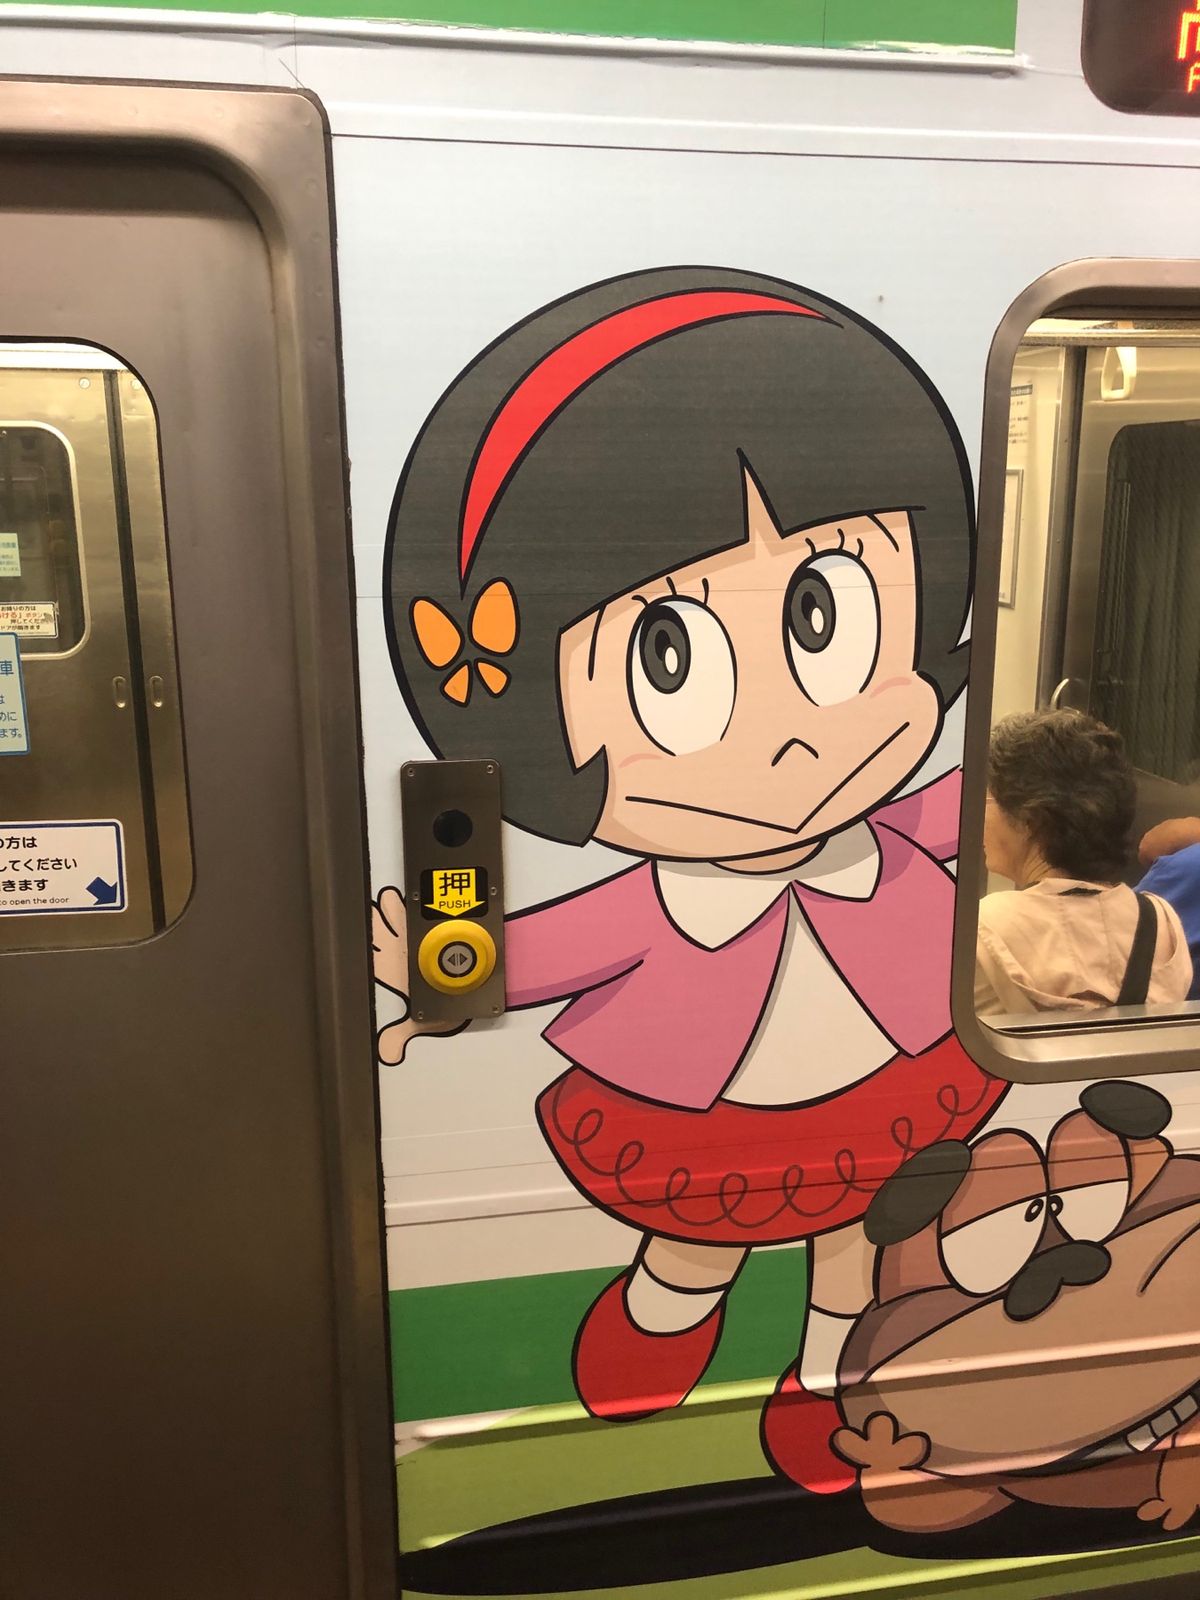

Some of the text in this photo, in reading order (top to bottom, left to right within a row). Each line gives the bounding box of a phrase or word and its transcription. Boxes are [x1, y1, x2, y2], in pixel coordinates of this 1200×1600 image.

[0, 878, 48, 892] きます
[439, 872, 470, 896] 押
[9, 898, 31, 906] open
[439, 900, 471, 909] PUSH
